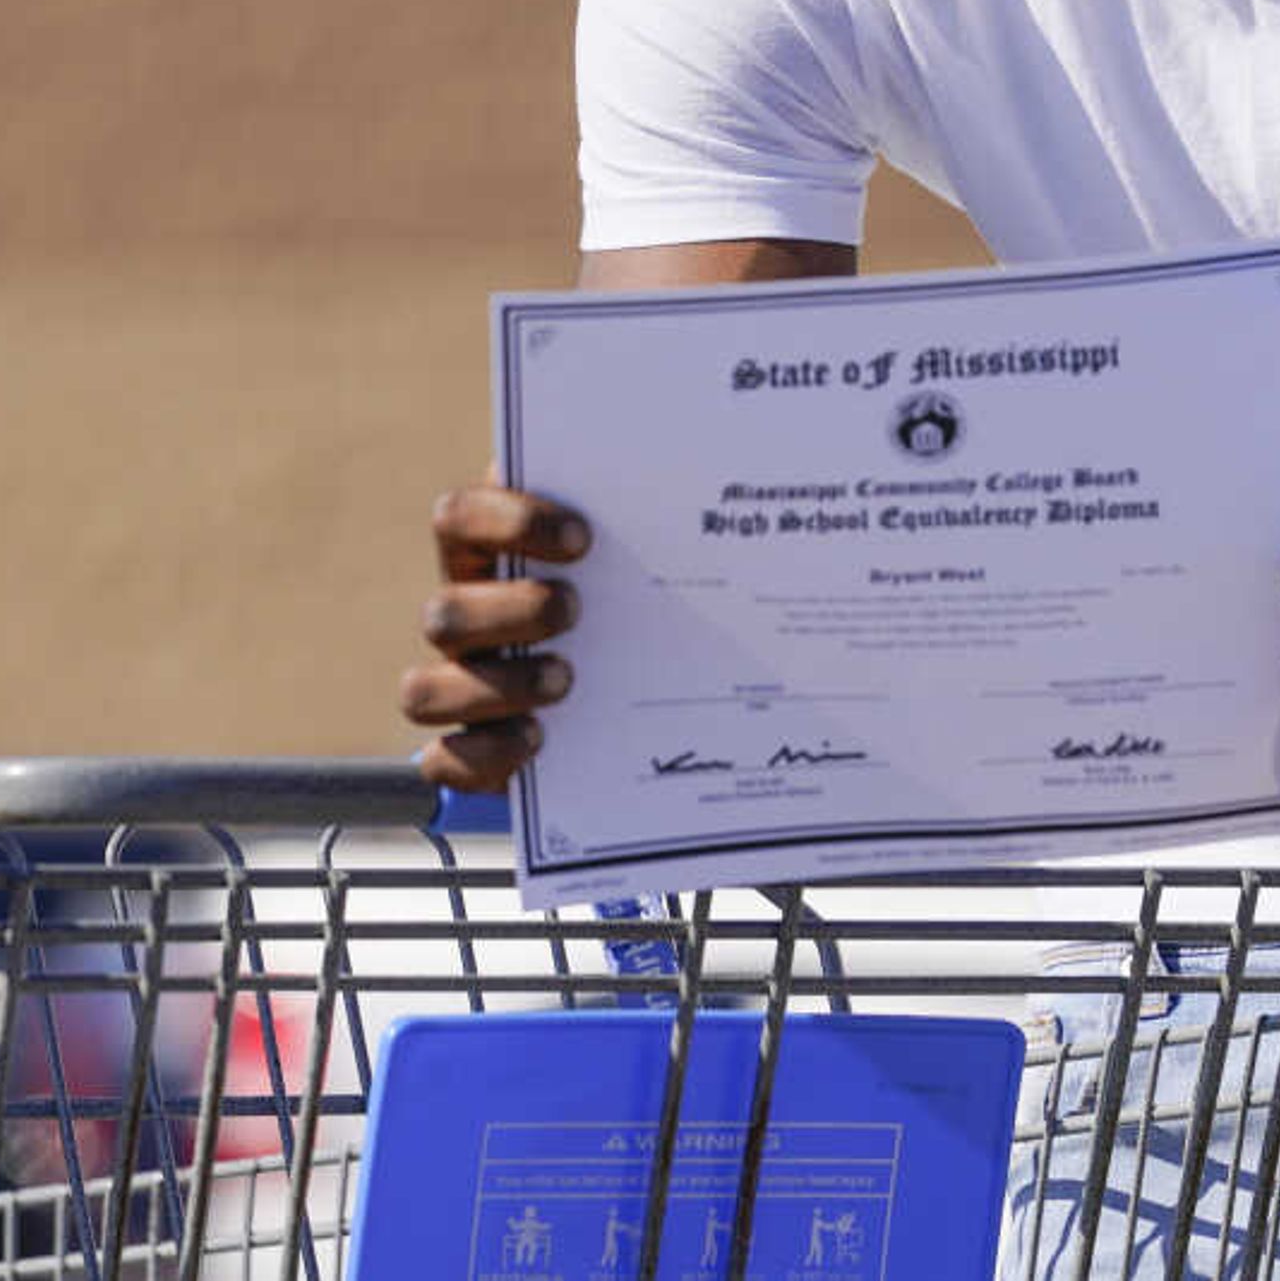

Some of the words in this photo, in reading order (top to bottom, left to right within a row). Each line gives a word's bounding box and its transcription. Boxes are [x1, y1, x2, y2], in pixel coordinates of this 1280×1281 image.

[731, 358, 831, 391] State
[910, 337, 1120, 384] Mississippi
[720, 481, 846, 504] Mississippi
[856, 475, 977, 497] Community
[986, 469, 1064, 494] College
[1073, 466, 1139, 487] Board
[700, 509, 769, 537] High
[777, 508, 869, 534] School
[878, 504, 1038, 532] Equivalency
[1046, 498, 1160, 526] Diploma
